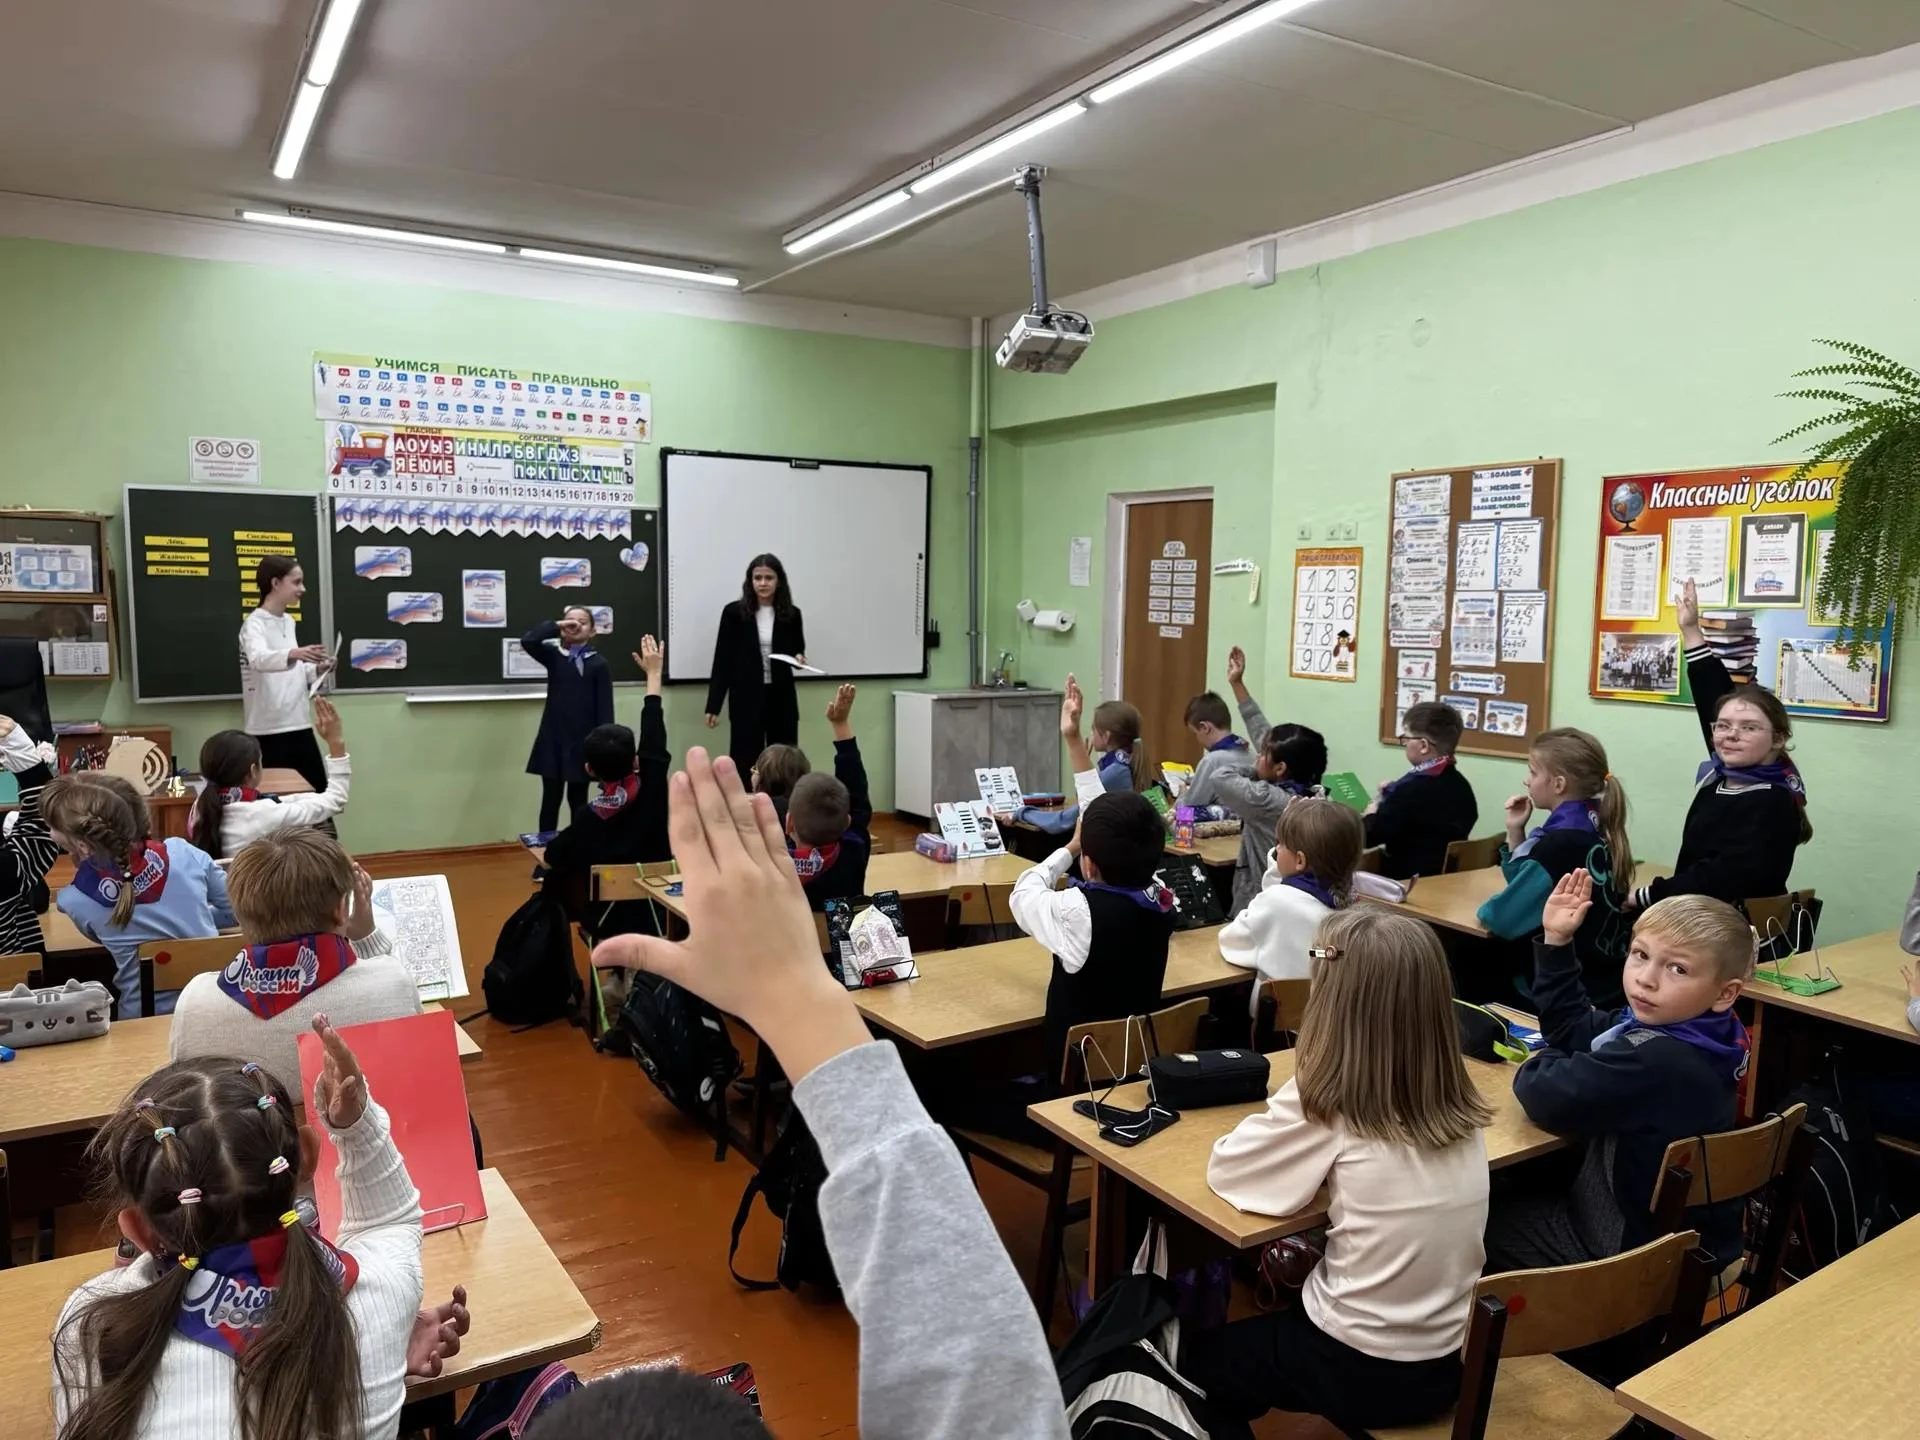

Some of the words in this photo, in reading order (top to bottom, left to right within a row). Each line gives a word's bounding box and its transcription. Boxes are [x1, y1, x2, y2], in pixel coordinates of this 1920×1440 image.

[375, 357, 440, 374] УЧИМСЯ
[457, 364, 518, 381] ПИСАТЬ
[532, 372, 619, 390] ПРАВИЛЬНО
[483, 486, 495, 495] 10
[499, 486, 509, 495] 11
[513, 487, 524, 496] 12
[527, 488, 538, 497] 13
[541, 488, 552, 498] 14
[555, 489, 566, 499] 15
[569, 490, 580, 499] 16
[583, 491, 592, 500] 17
[596, 491, 606, 501] 18
[610, 492, 620, 501] 19
[622, 493, 633, 502] 20
[1650, 476, 1750, 509] Классный
[1751, 478, 1836, 512] уголок
[1308, 569, 1316, 592] 1
[1324, 569, 1337, 592] 2
[1344, 569, 1356, 592] 3
[1306, 596, 1315, 618] 4
[1323, 596, 1334, 619] 5
[1342, 596, 1355, 620] 6
[1303, 622, 1314, 644] 7
[1321, 623, 1333, 646] 8
[1301, 649, 1313, 671] 9
[1320, 650, 1332, 672] 0
[226, 951, 300, 986] Орлята
[242, 980, 300, 992] РОССИИ
